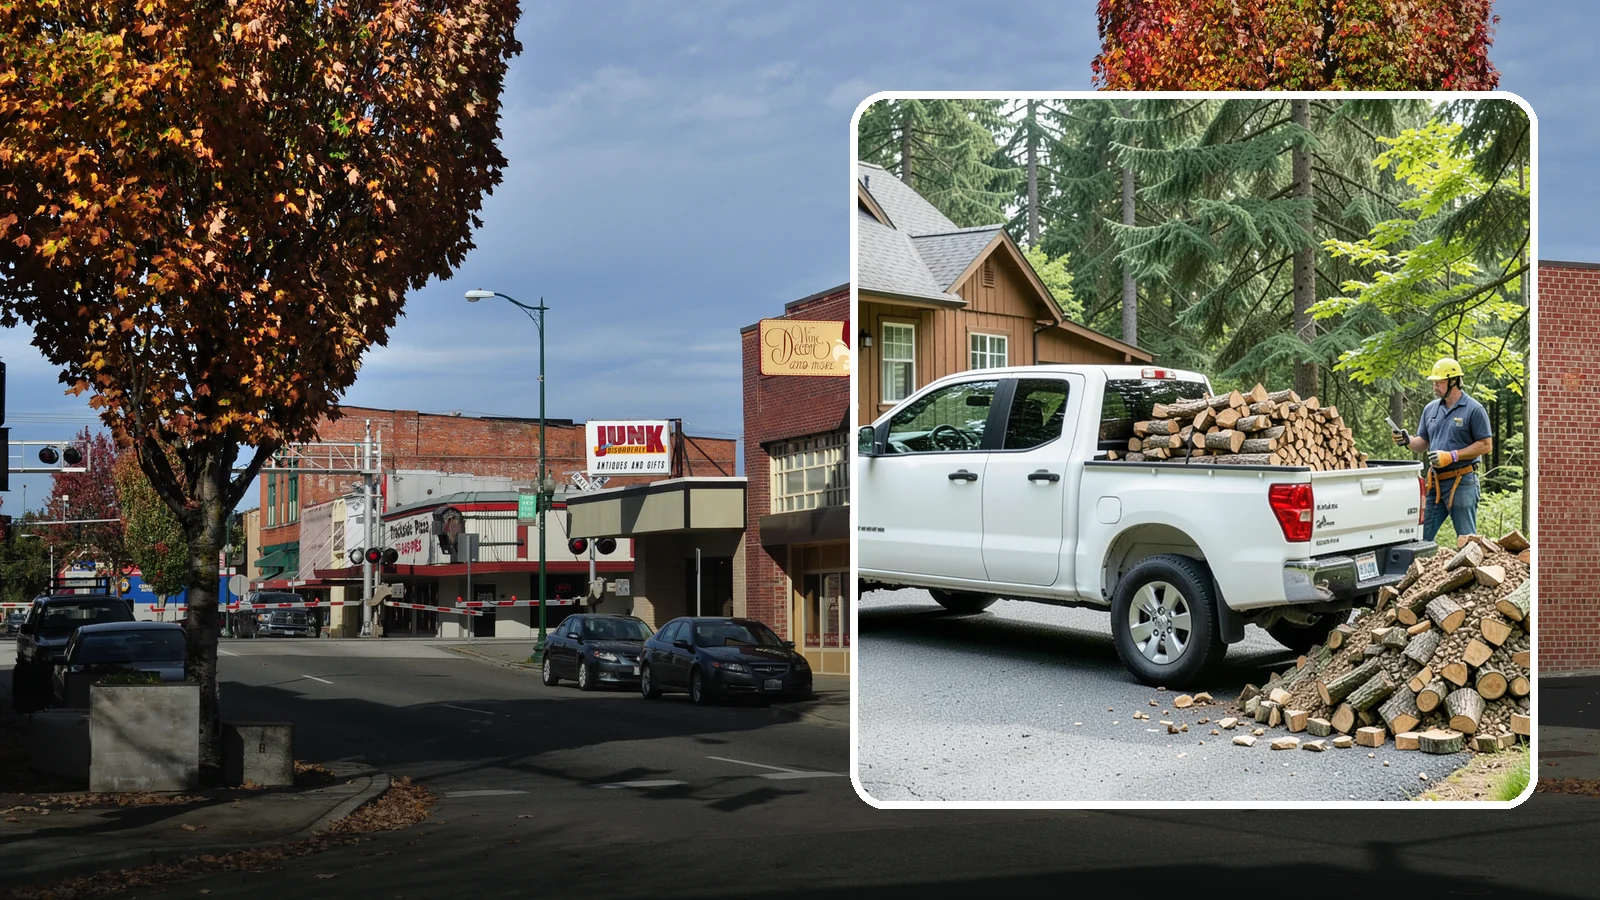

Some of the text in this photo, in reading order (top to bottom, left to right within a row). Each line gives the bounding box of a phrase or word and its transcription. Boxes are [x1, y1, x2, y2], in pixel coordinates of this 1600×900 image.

[765, 327, 831, 365] Decor
[595, 425, 665, 457] JUNK
[607, 446, 646, 454] DISORDERLY
[597, 460, 665, 470] ANTIQUES AND GIFTS
